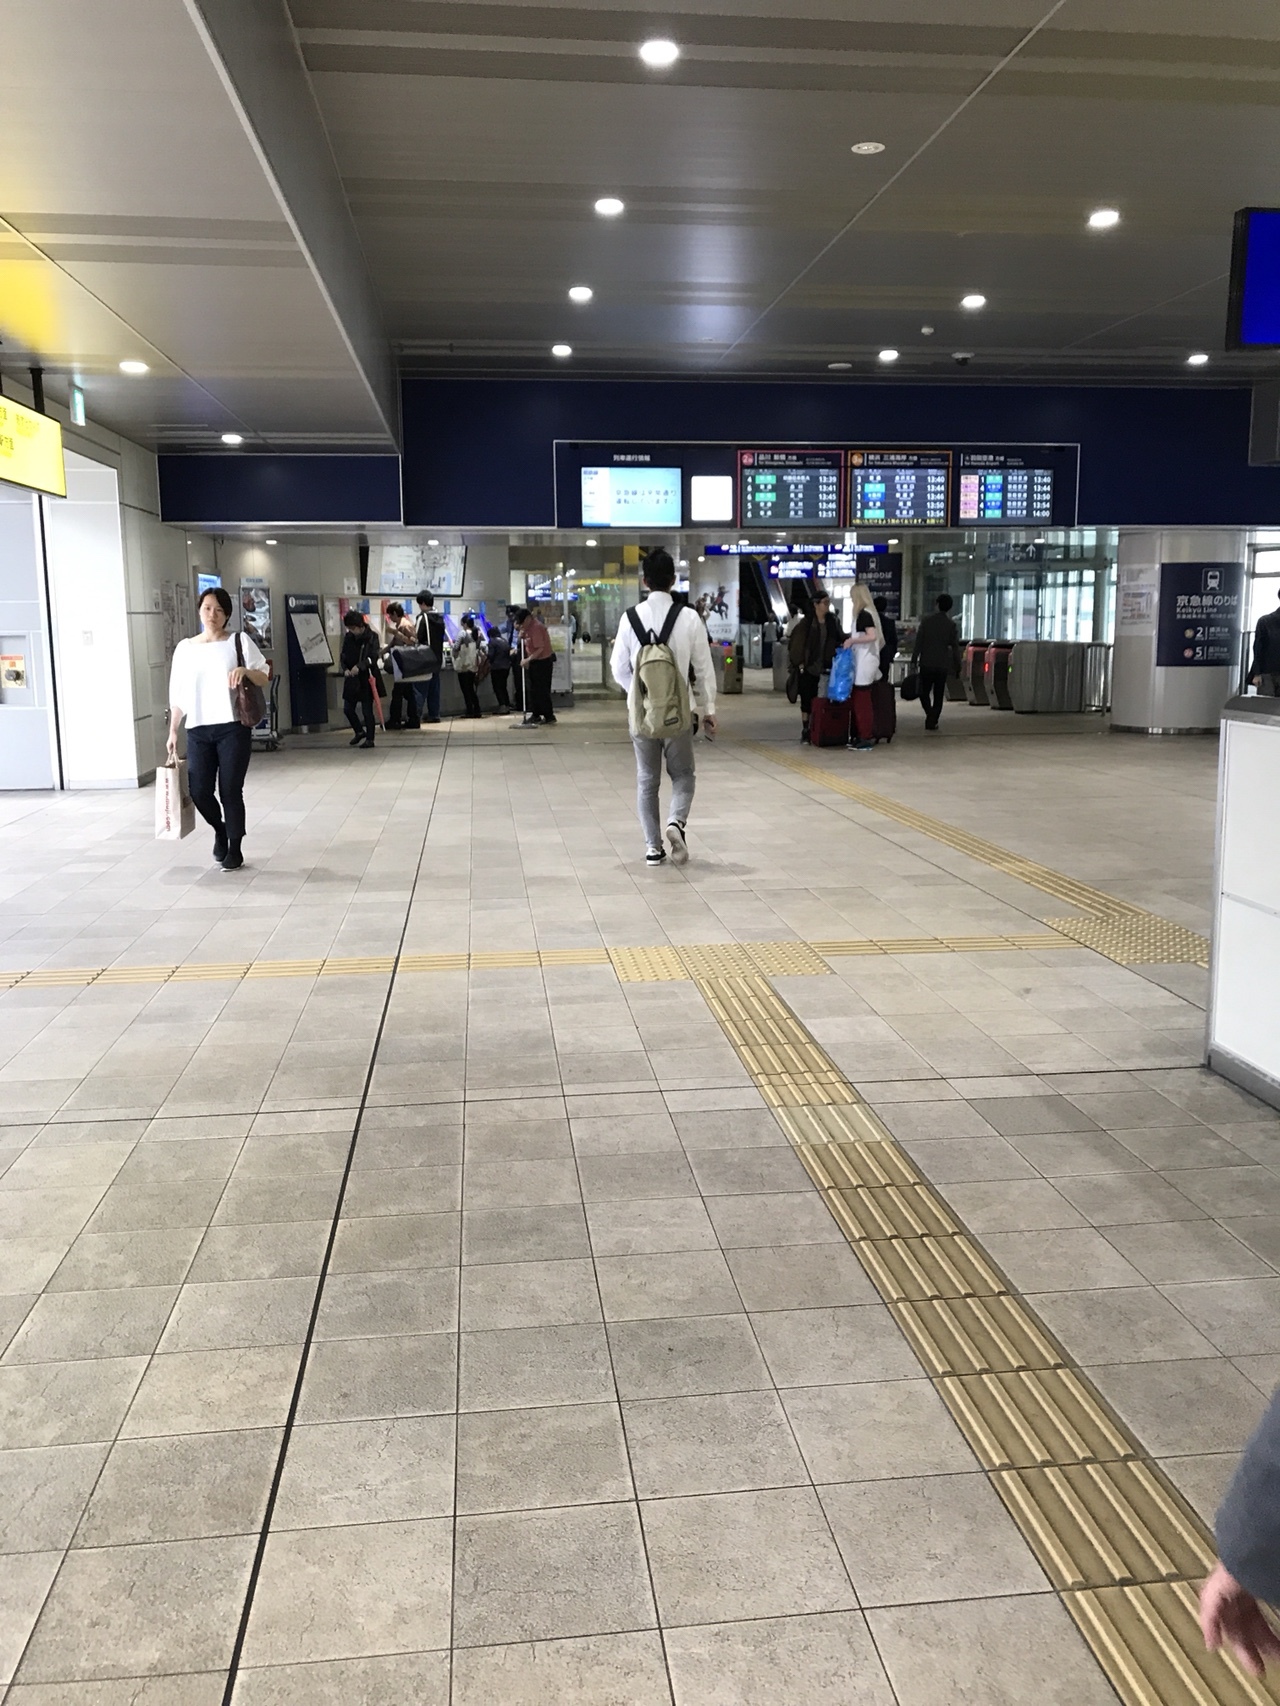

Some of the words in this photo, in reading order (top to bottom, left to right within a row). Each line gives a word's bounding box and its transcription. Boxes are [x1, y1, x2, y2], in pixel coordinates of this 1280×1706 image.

[1176, 595, 1238, 606] 京急線のりば
[1196, 626, 1203, 637] 2
[1195, 646, 1202, 657] 5
